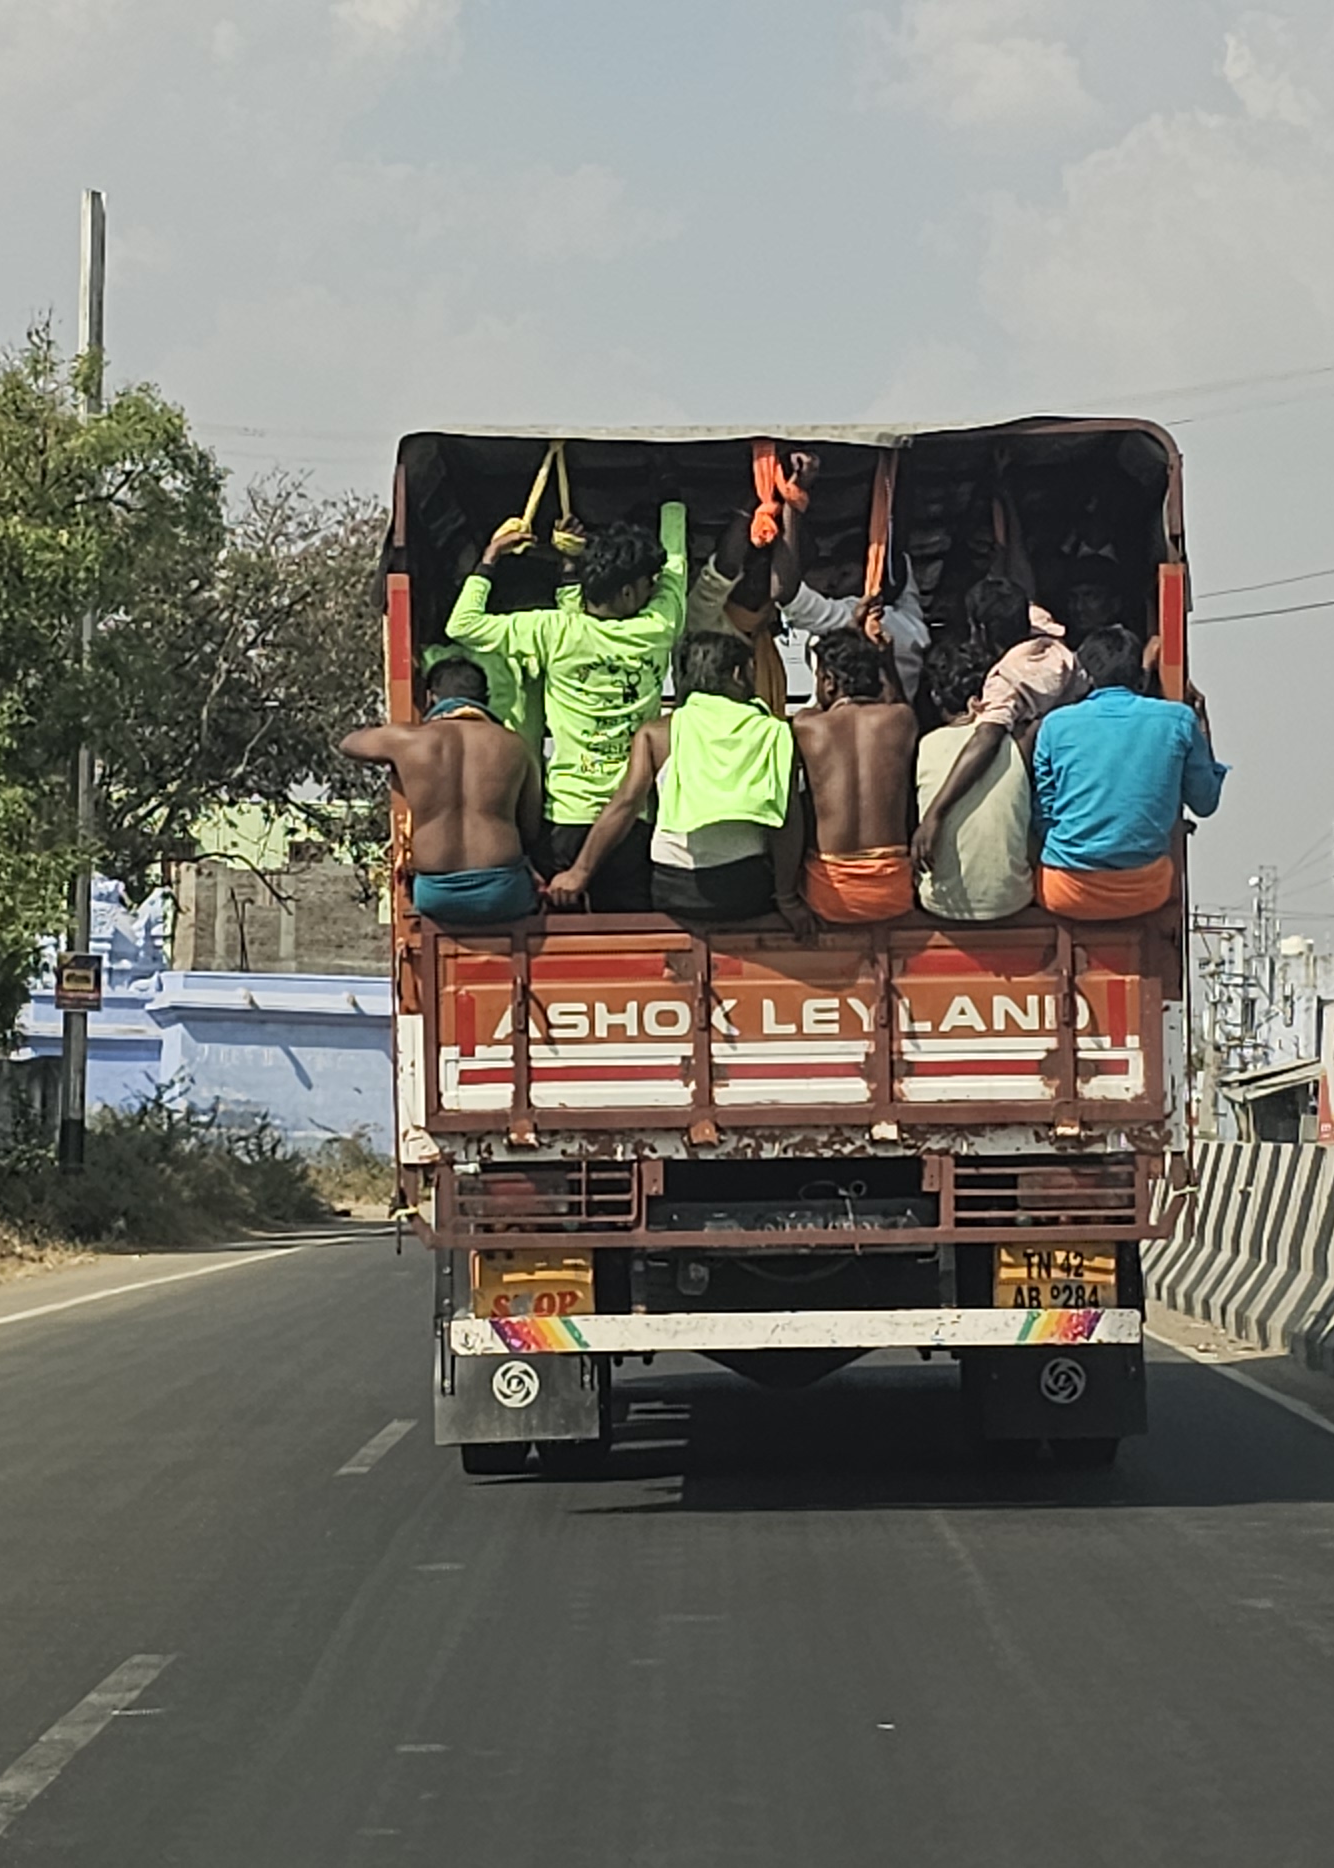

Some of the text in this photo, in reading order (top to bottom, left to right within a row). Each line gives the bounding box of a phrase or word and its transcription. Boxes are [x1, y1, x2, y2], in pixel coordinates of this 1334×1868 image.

[492, 994, 1090, 1040] ASHOK LEYLAND
[1023, 1250, 1084, 1279] TN 42
[490, 1290, 579, 1318] SOP
[1013, 1285, 1042, 1309] AB
